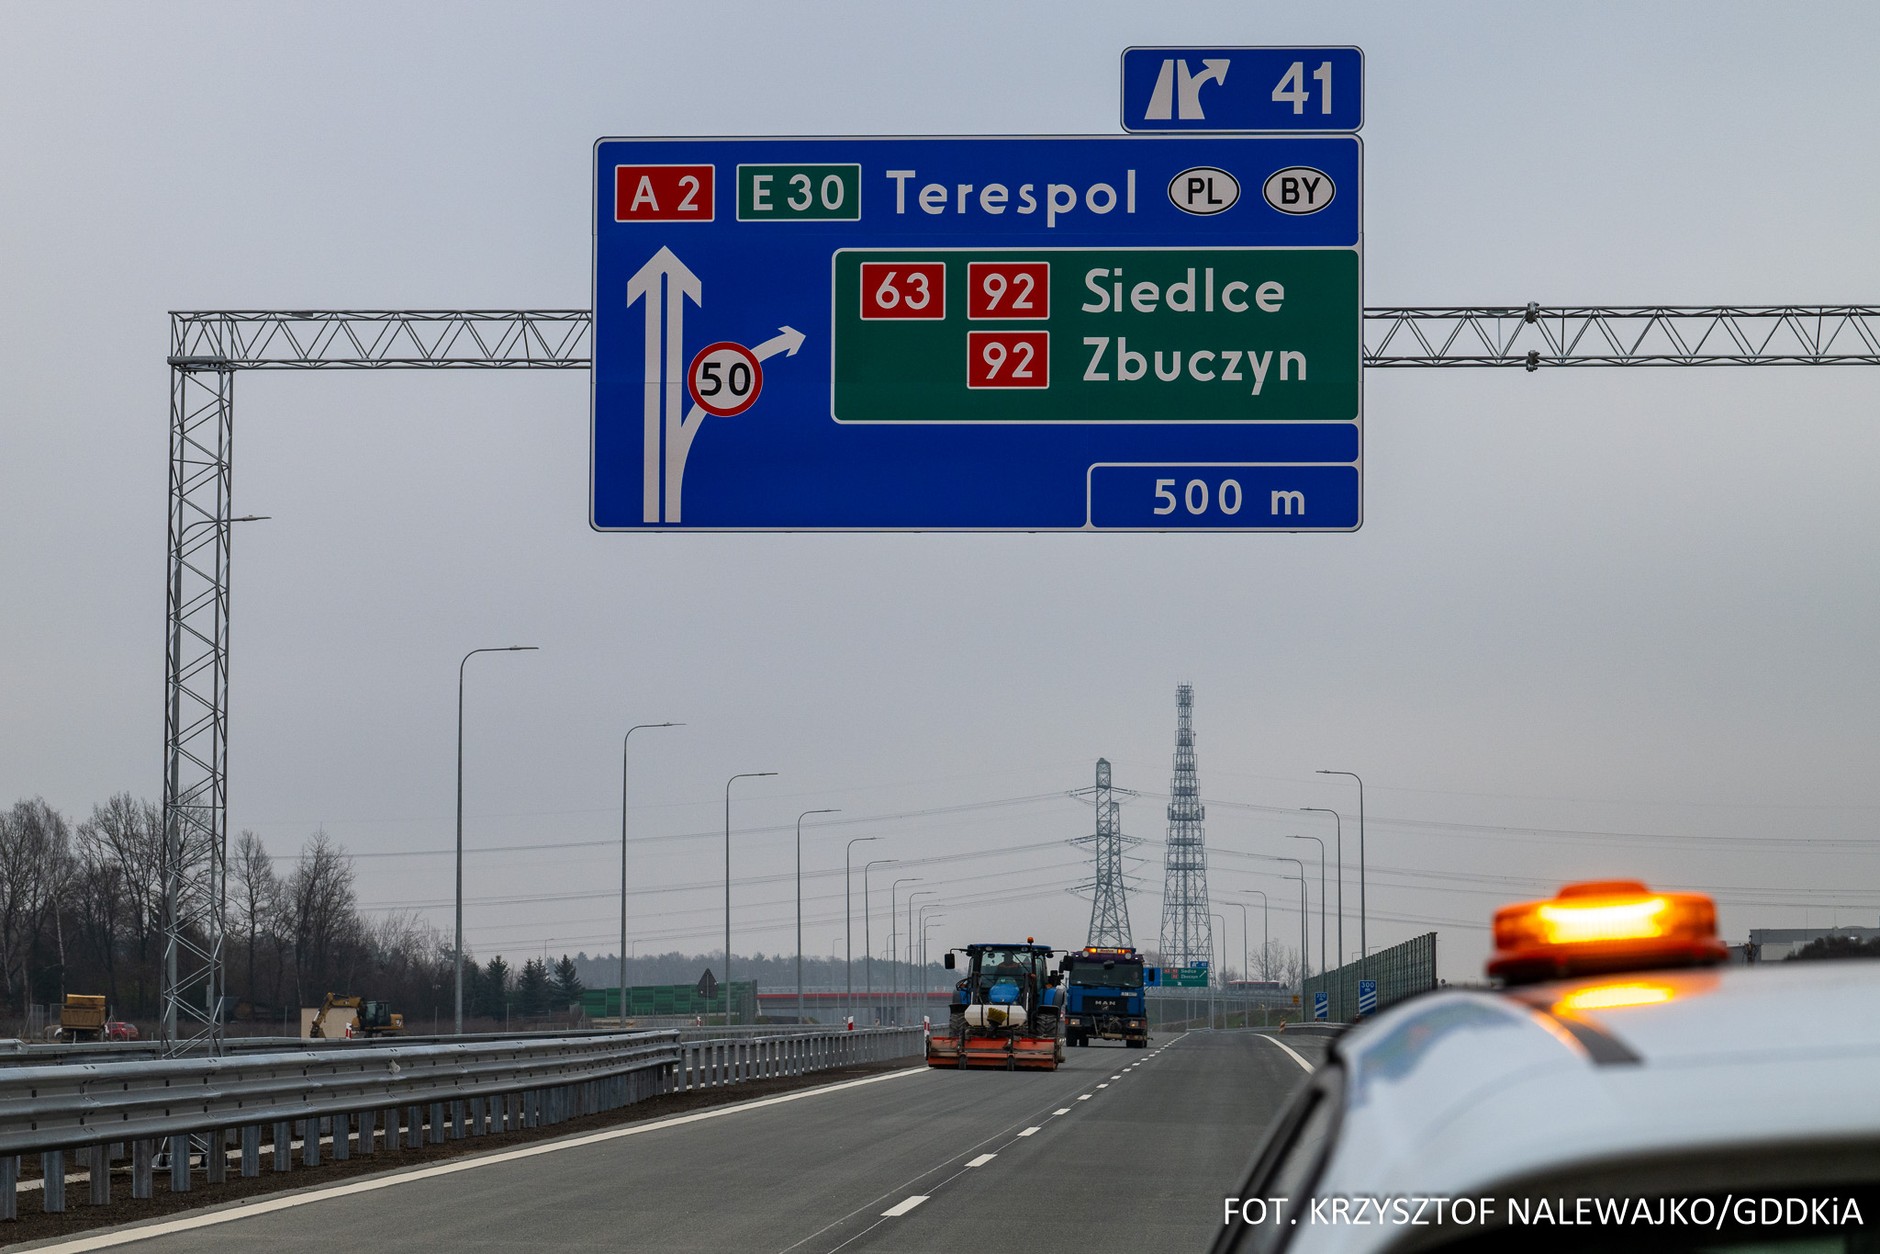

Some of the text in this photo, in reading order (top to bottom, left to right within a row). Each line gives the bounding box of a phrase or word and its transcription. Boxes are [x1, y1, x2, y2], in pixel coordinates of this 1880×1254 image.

[1271, 61, 1333, 116] 41
[630, 175, 701, 212] A 2
[753, 173, 845, 212] E 30
[886, 169, 1136, 228] Terespol
[1186, 174, 1223, 207] PL
[1282, 174, 1320, 206] BY
[875, 271, 931, 311] 63
[982, 272, 1035, 311] 92
[1082, 267, 1285, 314] Siedlce
[699, 361, 753, 397] 50
[982, 341, 1035, 379] 92
[1083, 336, 1307, 396] Zbuczyn
[1153, 479, 1306, 515] 500 m
